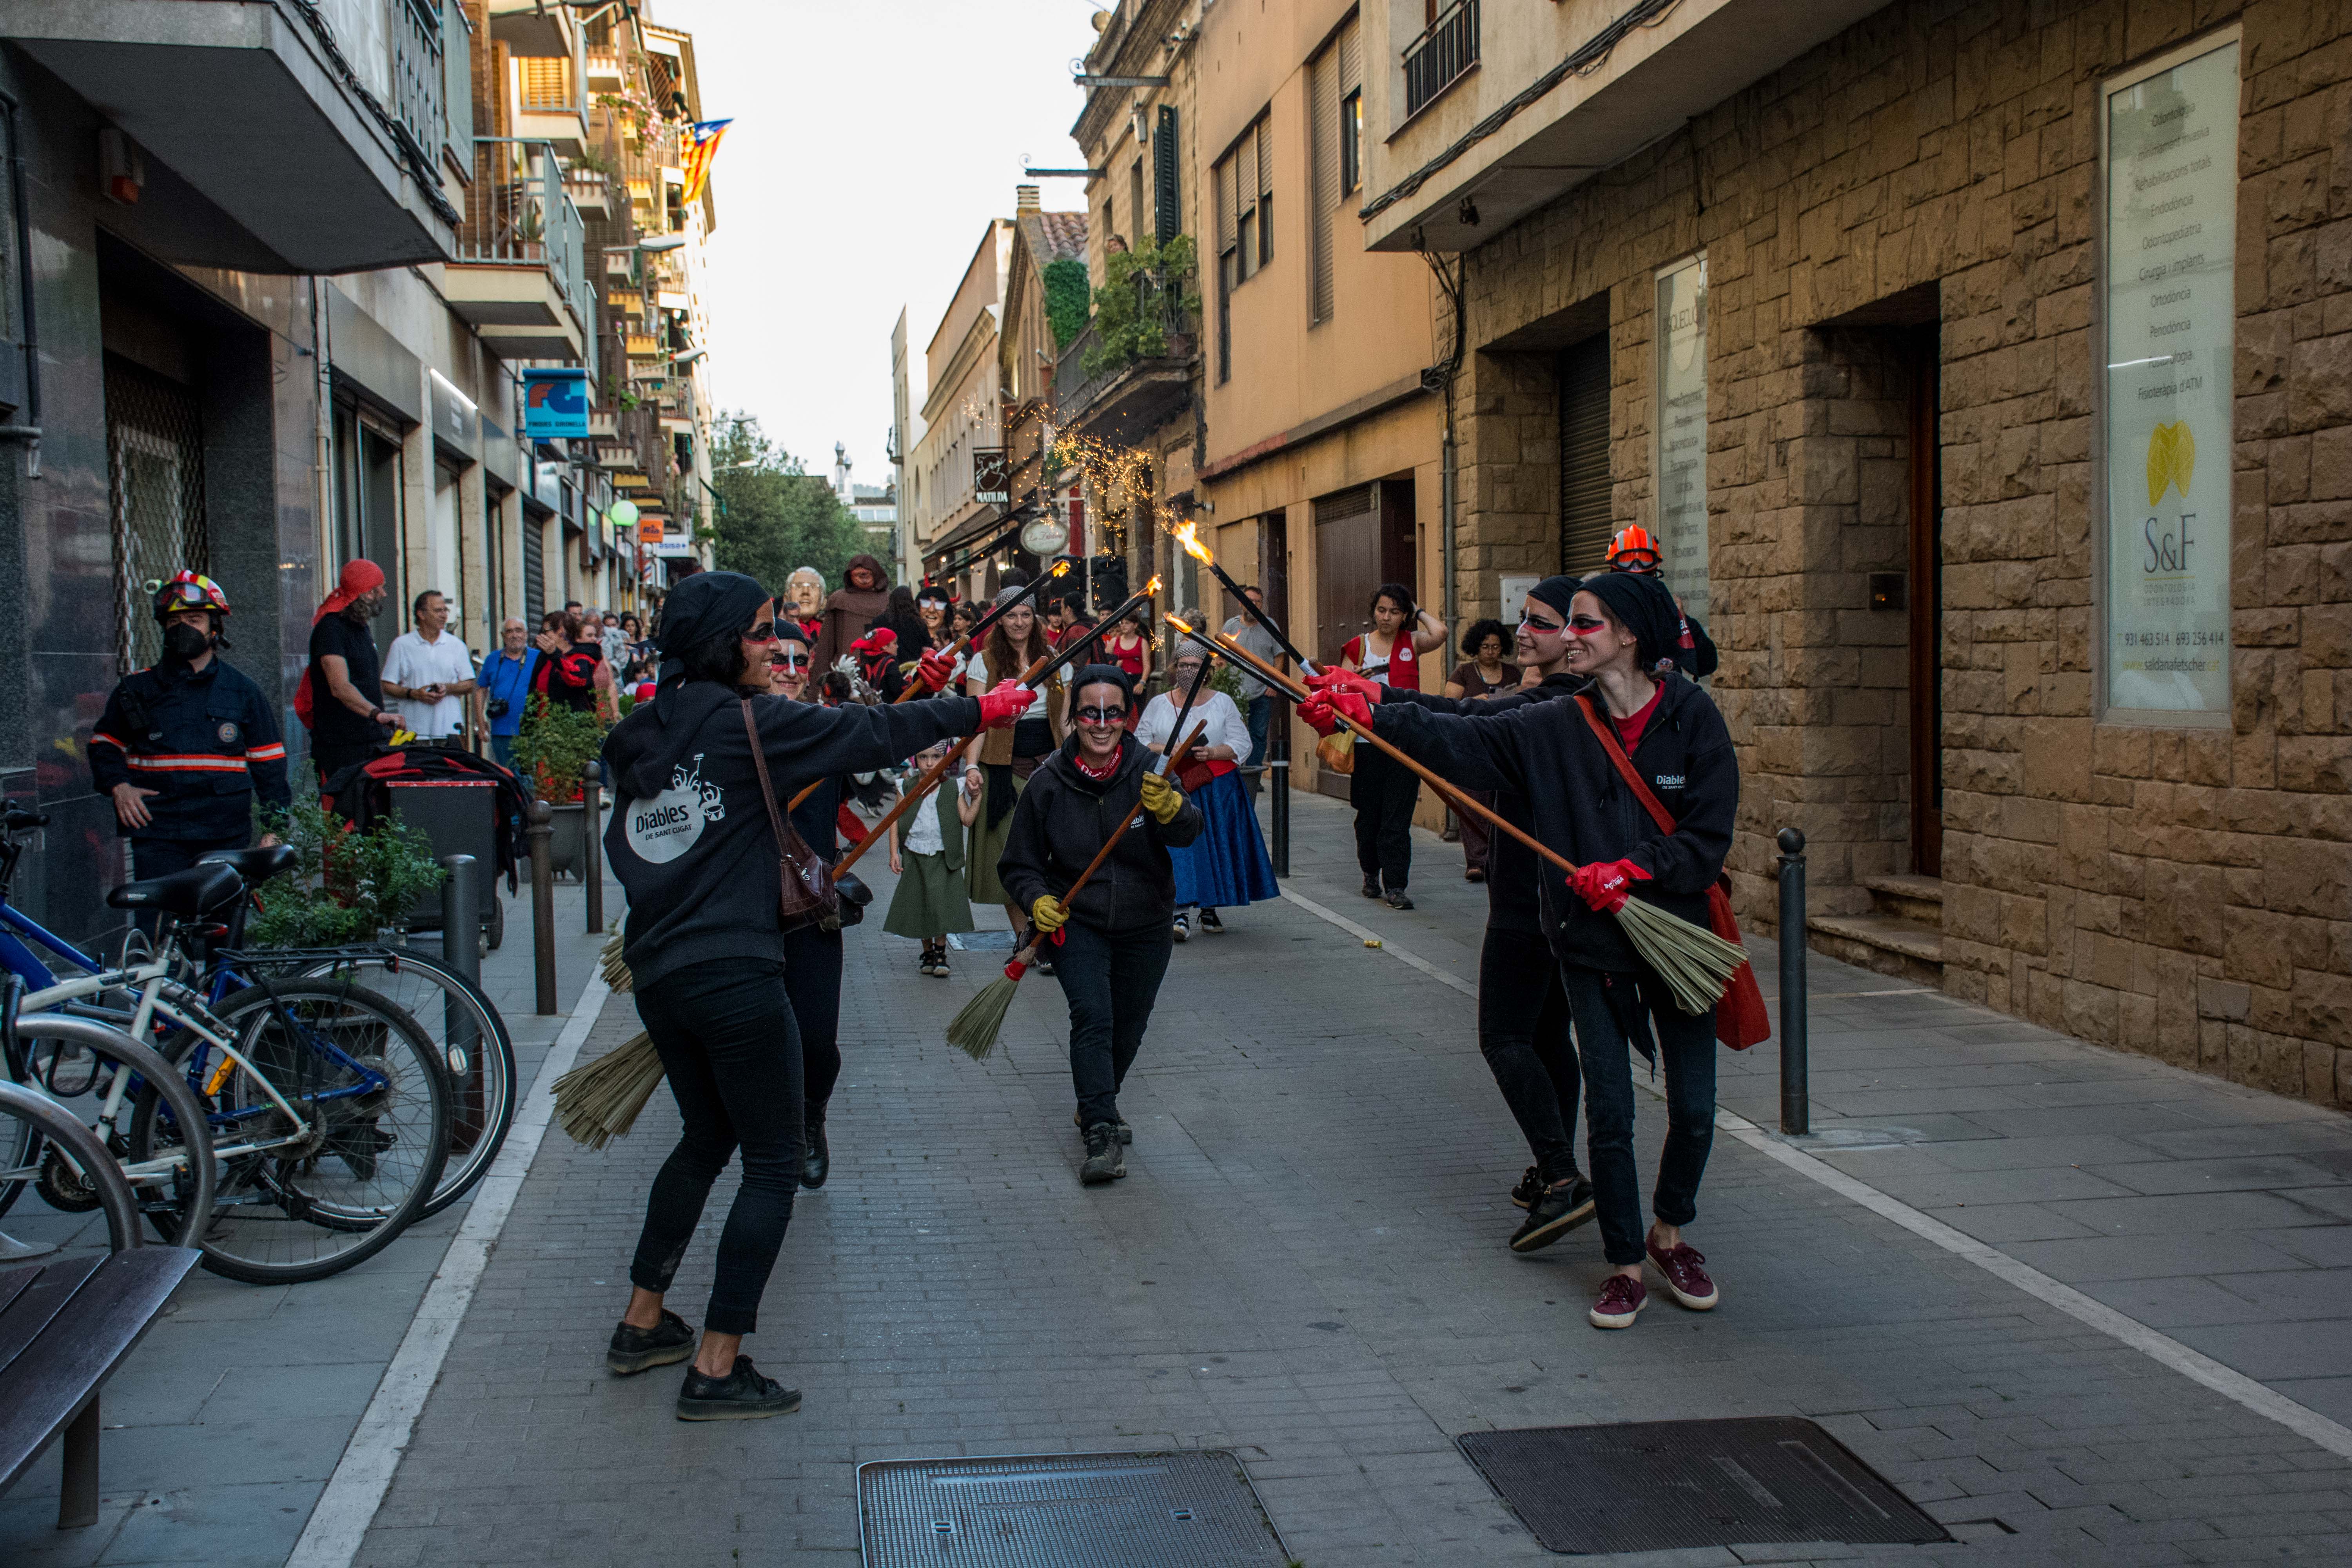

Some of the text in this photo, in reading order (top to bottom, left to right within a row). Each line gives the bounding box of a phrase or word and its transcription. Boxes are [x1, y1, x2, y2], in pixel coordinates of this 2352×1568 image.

[2139, 265, 2167, 281] Cirurgia
[2172, 254, 2204, 273] implants
[976, 491, 1008, 503] MATILDA
[2144, 513, 2196, 573] S&F
[2125, 633, 2137, 646] 931
[2139, 632, 2154, 646] 463
[2156, 632, 2169, 646] 514
[2176, 632, 2190, 646] 693
[2192, 632, 2207, 646] 256
[2209, 632, 2224, 645] 414
[635, 805, 690, 834] Diables
[646, 824, 692, 840] DE SANT CUGAT
